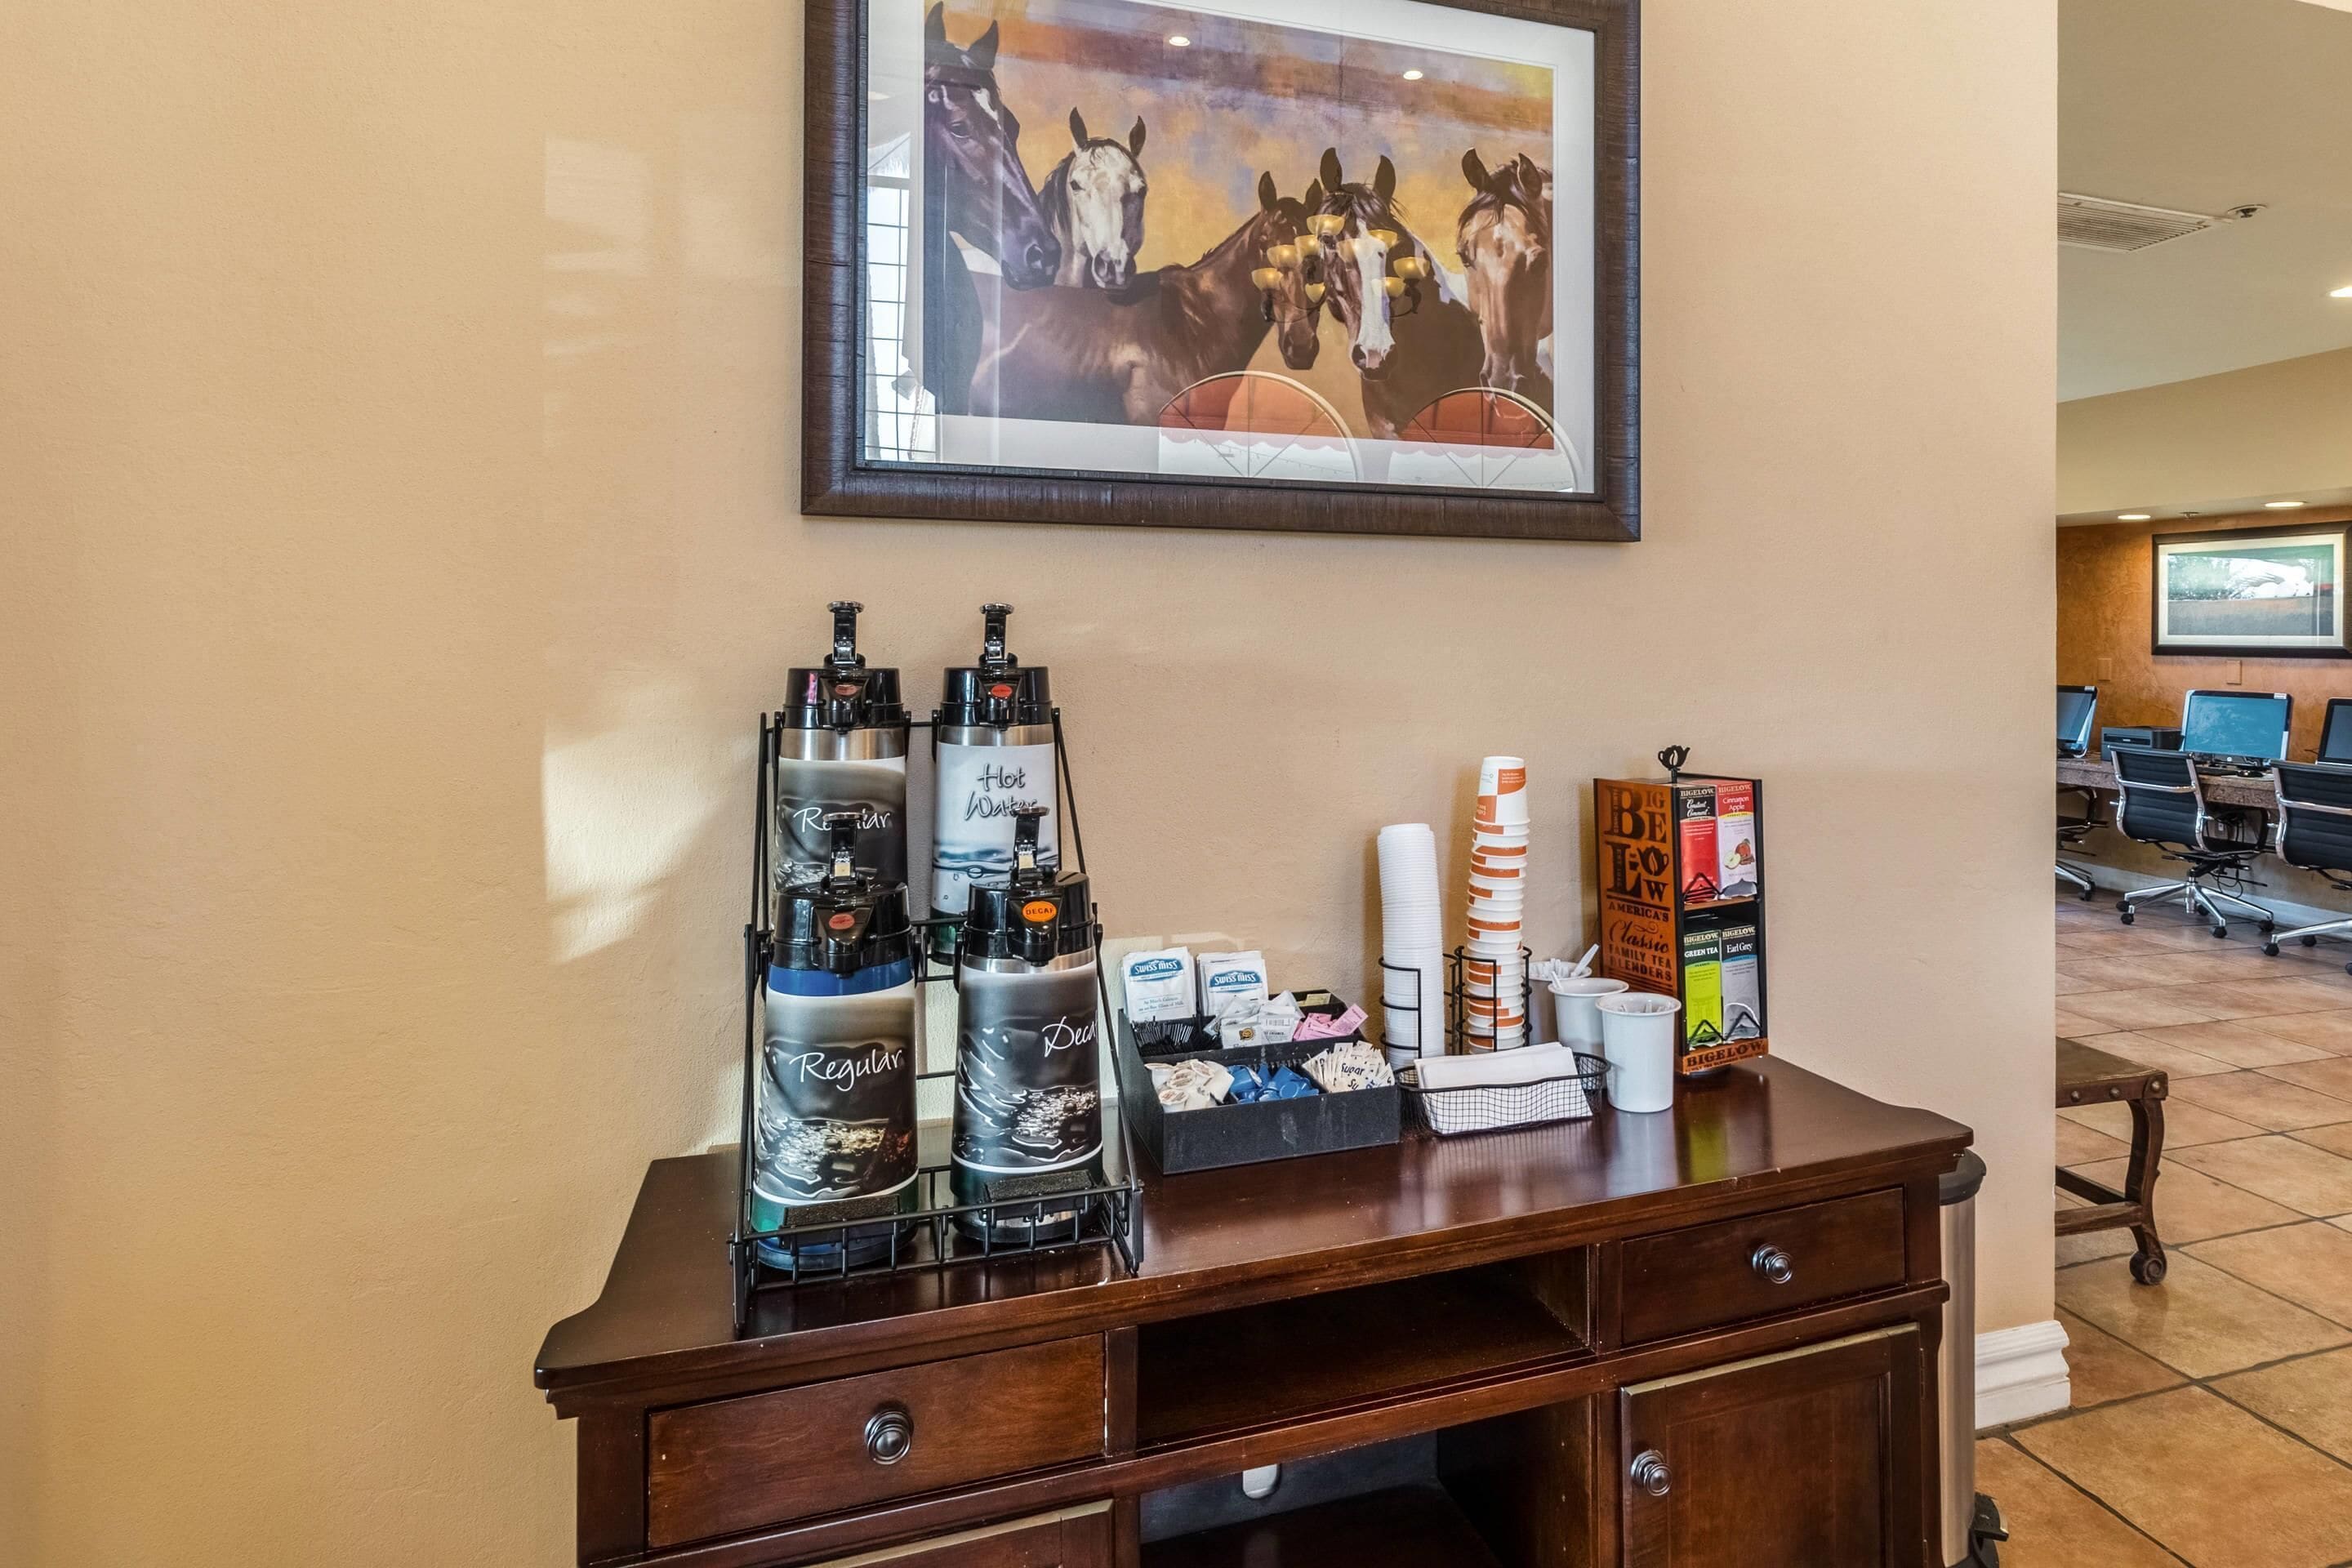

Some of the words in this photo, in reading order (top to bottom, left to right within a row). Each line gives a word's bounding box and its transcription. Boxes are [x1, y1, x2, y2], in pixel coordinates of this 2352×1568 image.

[977, 763, 1026, 791] Hot
[1680, 787, 1715, 797] BIGELOW
[1717, 784, 1752, 794] BIGELOW
[964, 791, 1037, 822] Water
[1722, 796, 1749, 804] Cinnamon
[1729, 804, 1745, 813] Apple
[792, 806, 891, 833] Relar
[1026, 907, 1054, 915] DECAF
[1608, 901, 1669, 922] AMERICA'S
[1609, 920, 1669, 954] Classic
[1684, 932, 1719, 944] BIGELOW
[1722, 926, 1756, 938] BIGELOW
[1684, 948, 1706, 958] GREEN
[1707, 947, 1719, 955] TEA
[1726, 943, 1739, 954] Earl
[1739, 942, 1753, 952] Grey
[1609, 943, 1646, 961] FAMILY
[1651, 954, 1673, 970] TEA
[1609, 956, 1673, 982] BLENDERS
[1686, 1040, 1766, 1067] BIGELOW
[788, 1049, 902, 1092] Regular
[1340, 1062, 1365, 1076] Sugar
